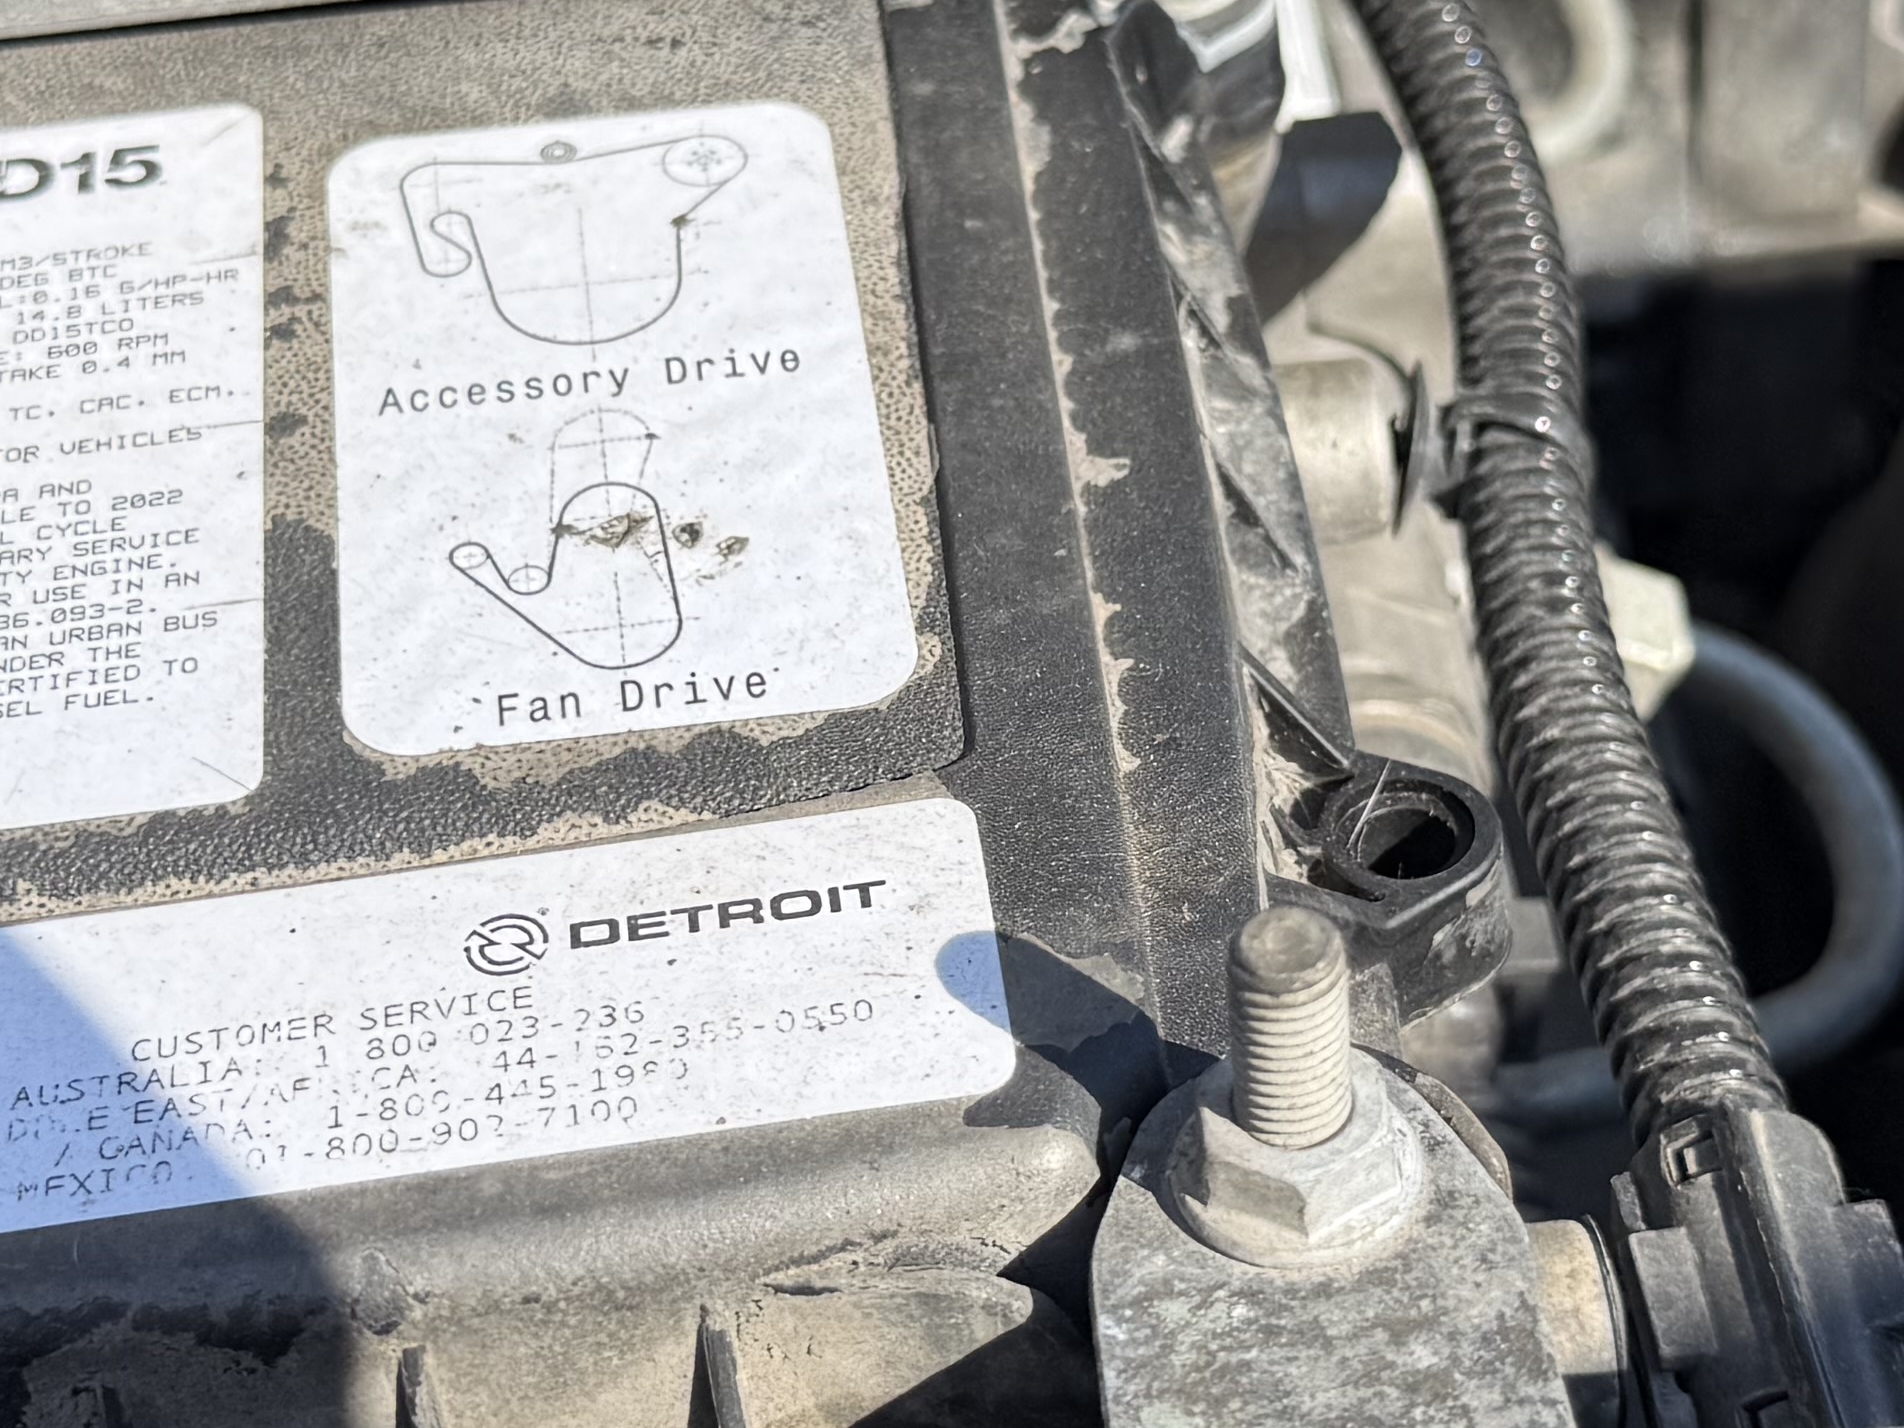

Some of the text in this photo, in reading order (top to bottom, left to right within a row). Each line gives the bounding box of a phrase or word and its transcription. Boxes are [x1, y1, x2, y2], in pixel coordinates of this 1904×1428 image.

[17, 304, 83, 326] 14.8
[100, 290, 205, 317] LITERS
[116, 332, 169, 352] RPM
[81, 355, 131, 375] 0.4
[151, 349, 186, 367] MM
[379, 346, 802, 417] Accessory Drive
[38, 478, 92, 500] AND
[56, 499, 91, 518] TO
[110, 488, 184, 512] 2022
[35, 515, 127, 542] CYCLE
[72, 527, 200, 558] SERVICE
[52, 552, 177, 582] ENGINE.
[31, 582, 86, 606] USE
[110, 576, 143, 597] IN
[163, 569, 200, 589] AN
[48, 619, 142, 647] URBAN
[162, 609, 219, 633] BUS
[86, 641, 141, 663] THE
[161, 656, 198, 677] TO
[63, 688, 154, 712] FUEL.
[496, 668, 769, 727] Fan Drive
[569, 879, 887, 951] DETROIT
[130, 984, 535, 1062] CUSTOMER SERVICE
